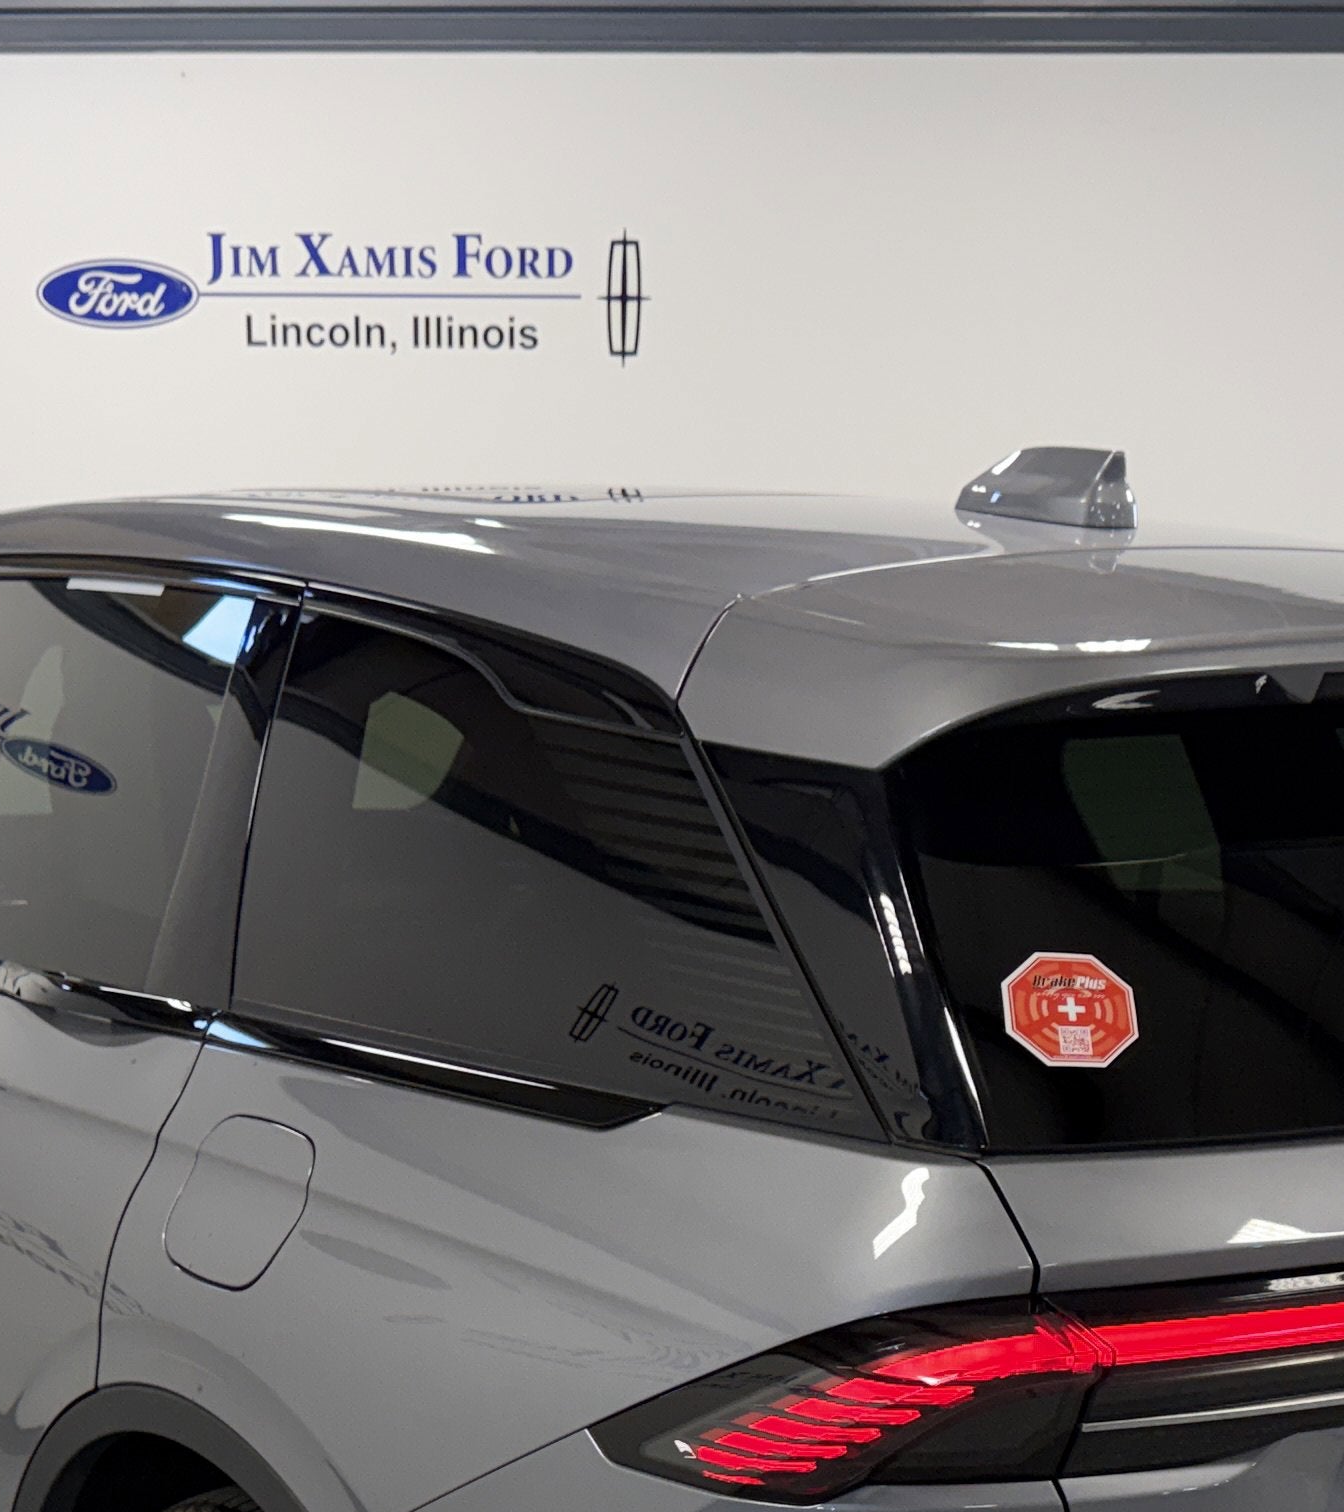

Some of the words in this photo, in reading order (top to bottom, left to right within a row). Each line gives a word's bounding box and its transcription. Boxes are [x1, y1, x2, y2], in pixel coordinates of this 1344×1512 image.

[207, 232, 280, 286] JIM
[295, 232, 437, 279] XAMIS
[452, 234, 573, 279] FORD
[69, 270, 166, 318] Ford
[246, 315, 397, 354] Lincoln,
[413, 317, 539, 351] Illinois
